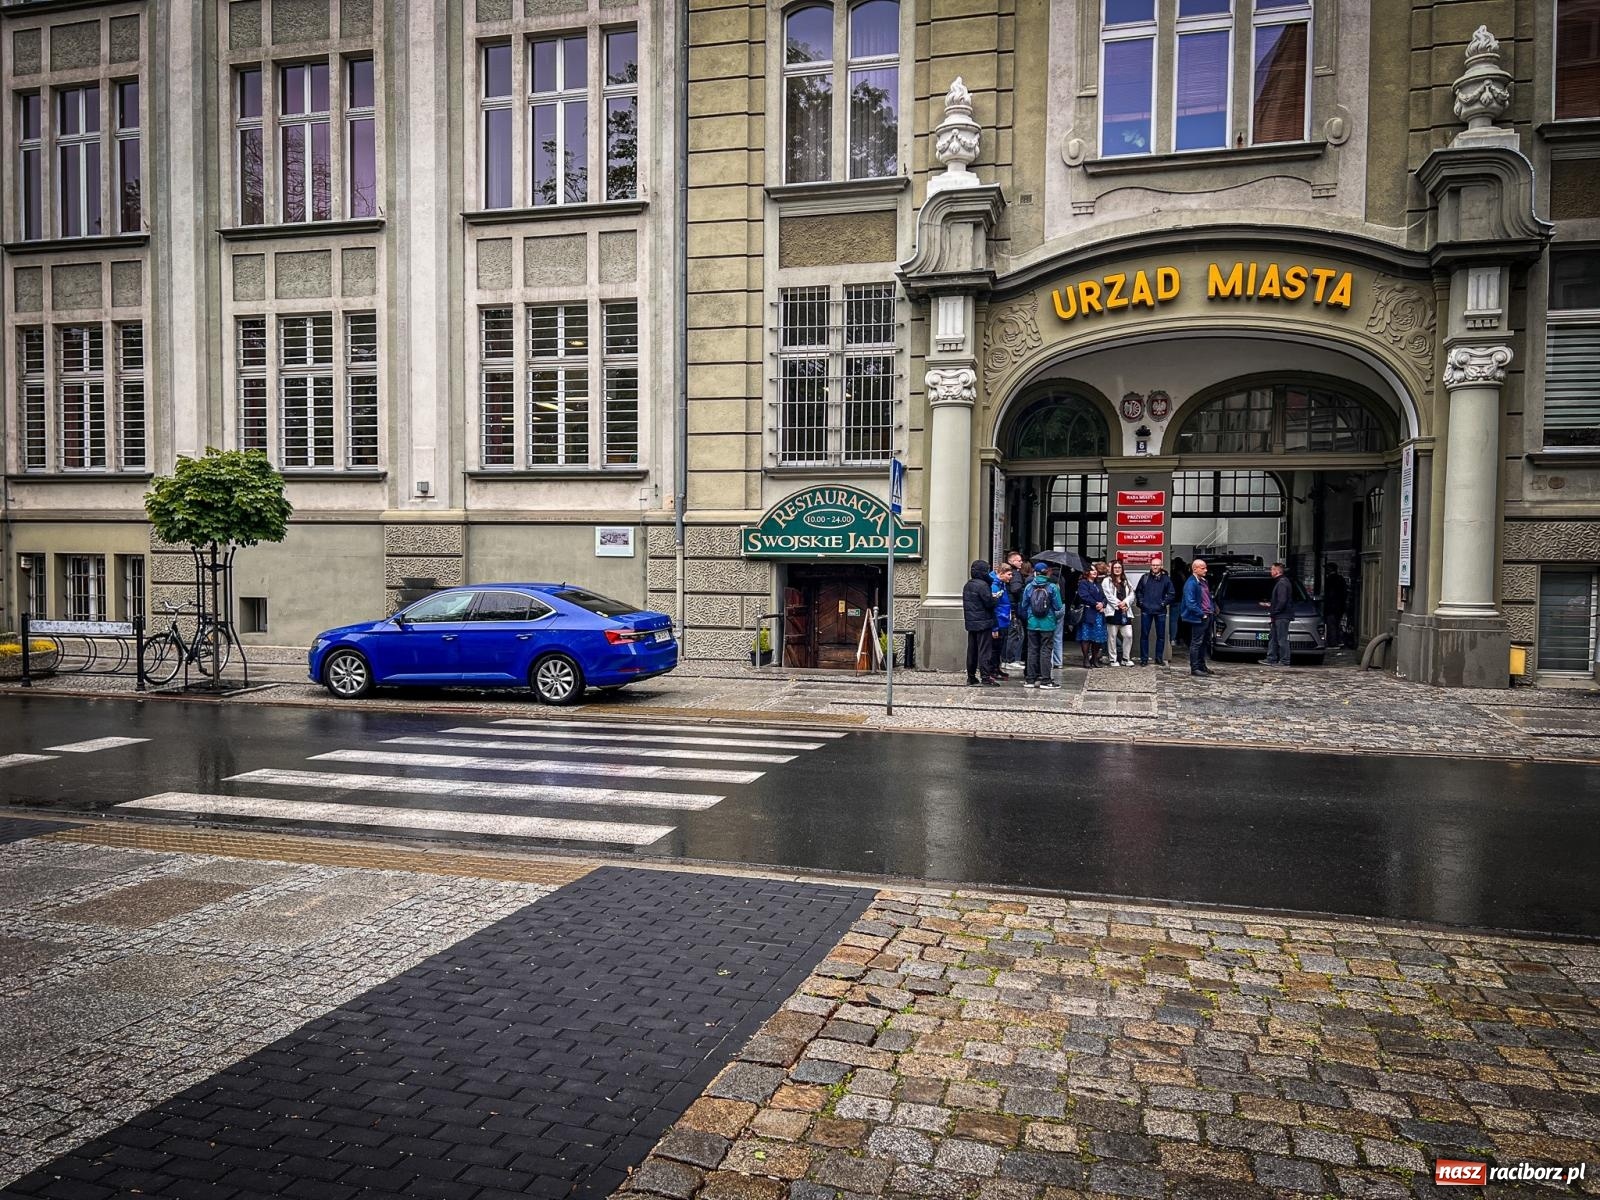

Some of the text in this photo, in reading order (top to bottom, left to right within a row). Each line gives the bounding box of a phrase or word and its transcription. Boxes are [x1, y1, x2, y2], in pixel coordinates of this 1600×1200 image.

[1052, 261, 1353, 320] URZAD MIASTA
[771, 489, 887, 535] RESTAURACJA
[806, 515, 826, 524] 10.00
[832, 515, 852, 524] 24.00
[748, 532, 843, 551] SWOJSKIE
